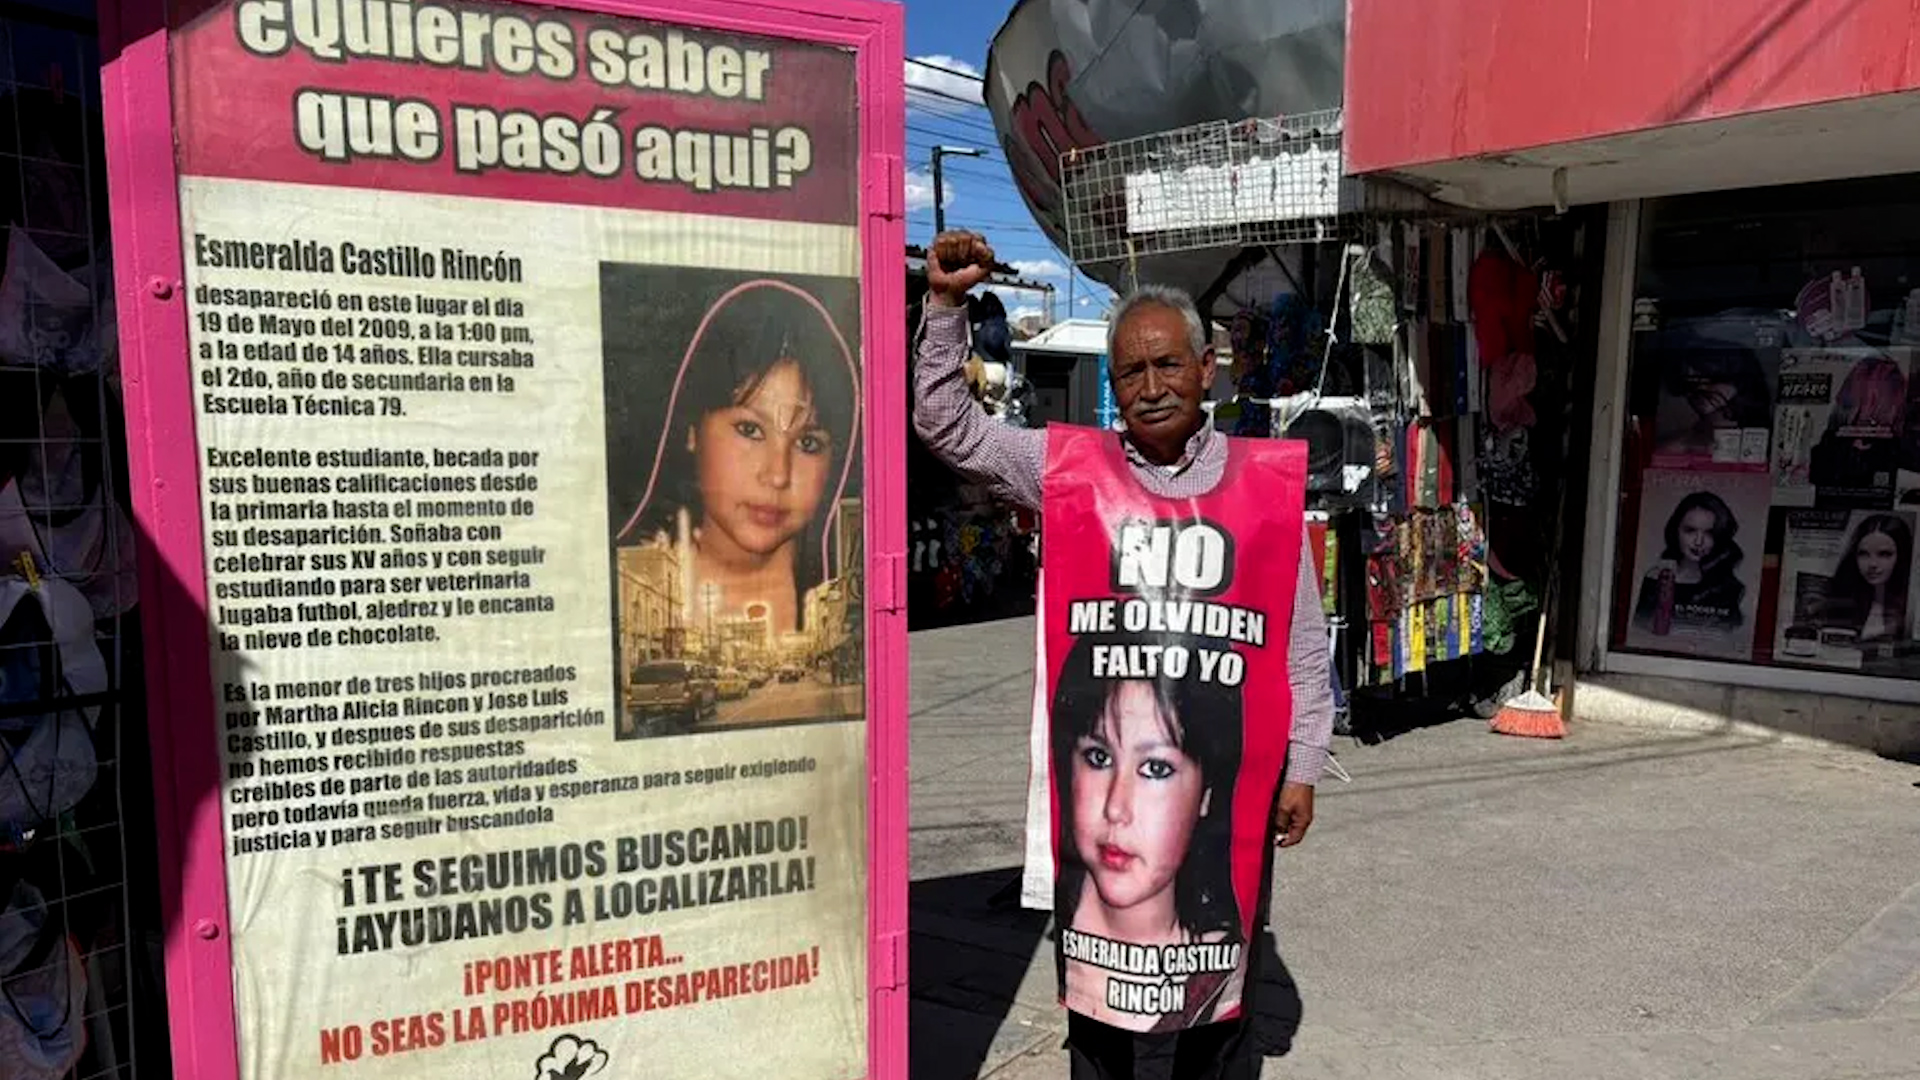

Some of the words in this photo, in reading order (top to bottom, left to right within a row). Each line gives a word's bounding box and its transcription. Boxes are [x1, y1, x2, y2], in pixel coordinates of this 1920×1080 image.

[589, 27, 771, 99] saber
[296, 90, 439, 157] que
[456, 108, 621, 175] pasó
[637, 126, 810, 189] aqui?
[195, 234, 333, 272] Esmeralda
[341, 242, 435, 279] Castillo
[441, 249, 522, 282] Rincón
[196, 285, 331, 311] desapareció
[337, 293, 361, 311] en
[368, 295, 411, 313] este
[416, 295, 466, 317] lugar
[472, 298, 489, 317] el
[199, 312, 221, 332] 19
[228, 314, 253, 333] de
[260, 315, 314, 338] Mayo
[321, 318, 353, 337] del
[360, 318, 414, 340] 2009,
[420, 325, 431, 339] a
[436, 322, 452, 340] la
[458, 323, 495, 341] 1:00
[501, 326, 534, 344] pm,
[200, 343, 212, 360] a
[218, 340, 237, 360] la
[244, 341, 296, 361] edad
[302, 343, 327, 362] de
[333, 344, 354, 362] 14
[361, 345, 413, 365] años.
[419, 347, 452, 365] Ella
[458, 349, 534, 368] cursaba
[202, 368, 221, 387] el
[228, 368, 272, 390] 2do,
[278, 368, 317, 389] año
[322, 370, 346, 390] de
[353, 372, 464, 391] secundaria
[470, 376, 492, 392] en
[497, 374, 514, 392] la
[204, 394, 287, 414] Escuela
[293, 396, 374, 416] Técnica
[380, 397, 406, 416] 79.
[208, 449, 310, 468] Excelente
[317, 449, 429, 468] estudiante,
[434, 449, 502, 467] becada
[509, 451, 538, 469] por
[209, 475, 247, 493] sus
[253, 474, 330, 493] buenas
[336, 473, 476, 492] calificaciones
[481, 472, 538, 491] desde
[211, 501, 231, 521] la
[236, 500, 328, 521] primaria
[334, 499, 388, 518] hasta
[394, 499, 411, 518] el
[418, 499, 506, 517] momento
[511, 498, 534, 516] de
[213, 528, 238, 546] su
[244, 524, 386, 546] desaparición.
[391, 523, 461, 542] Soñaba
[468, 524, 501, 540] con
[214, 553, 305, 573] celebrar
[311, 552, 346, 570] sus
[352, 550, 375, 569] XV
[381, 548, 427, 568] años
[433, 552, 442, 569] y
[447, 550, 481, 566] con
[487, 547, 545, 568] seguir
[1118, 525, 1224, 588] NO
[216, 578, 335, 599] estudiando
[341, 578, 384, 598] para
[391, 577, 421, 593] ser
[427, 572, 529, 591] veterinaria
[367, 599, 438, 620] ajedrez
[442, 600, 451, 618] y
[457, 598, 474, 615] le
[480, 596, 554, 614] encanta
[1070, 602, 1115, 632] ME
[1124, 601, 1264, 645] OLVIDEN
[221, 632, 239, 651] la
[246, 632, 301, 649] nieve
[308, 628, 332, 646] de
[338, 625, 439, 645] chocolate.
[224, 683, 245, 702] Es
[251, 682, 270, 700] la
[276, 679, 341, 698] menor
[347, 675, 370, 695] de
[376, 674, 413, 693] tres
[419, 670, 466, 692] hijos
[471, 665, 575, 688] procreados
[1093, 646, 1189, 678] FALTO
[1199, 649, 1244, 685] YO
[226, 710, 259, 730] por
[266, 703, 337, 724] Martha
[344, 699, 397, 720] Alicia
[404, 694, 469, 715] Rincon
[474, 694, 483, 713] y
[489, 690, 527, 710] Jose
[533, 688, 568, 707] Luis
[228, 728, 311, 752] Castillo,
[317, 729, 325, 748] y
[332, 721, 415, 746] despues
[421, 718, 442, 738] de
[448, 718, 480, 736] sus
[486, 708, 604, 734] desaparición
[230, 760, 253, 778] no
[260, 753, 327, 777] hemos
[335, 749, 415, 770] recibido
[421, 739, 524, 765] respuestas
[231, 776, 314, 803] creibles
[322, 775, 345, 796] de
[351, 771, 400, 794] parte
[408, 769, 429, 788] de
[435, 765, 462, 786] las
[468, 758, 576, 783] autoridades
[232, 808, 278, 830] pero
[285, 798, 358, 824] todavía
[364, 797, 423, 820] queda
[429, 788, 488, 811] fuerza,
[493, 783, 530, 805] vida
[535, 784, 544, 803] y
[552, 776, 638, 799] esperanza
[644, 771, 680, 790] para
[685, 764, 736, 785] seguir
[740, 757, 815, 778] exigiendo
[234, 827, 310, 855] justicia
[317, 829, 326, 847] y
[332, 821, 375, 845] para
[382, 817, 441, 839] seguir
[447, 806, 553, 832] buscandola
[342, 862, 403, 907] ¡TE
[414, 839, 606, 898] SEGUIMOS
[616, 817, 808, 874] BUSCANDO!
[337, 892, 552, 954] ¡AYUDANOS
[564, 885, 586, 925] A
[594, 857, 816, 921] LOCALIZARLA!
[463, 946, 562, 996] ¡PONTE
[570, 935, 683, 981] ALERTA...
[1063, 930, 1159, 975] ESMERALDA
[1163, 944, 1241, 974] CASTILLO
[321, 1028, 362, 1065] NO
[372, 1013, 445, 1056] SEAS
[453, 1008, 486, 1043] LA
[494, 987, 617, 1034] PRÓXIMA
[625, 947, 819, 1009] DESAPARECIDA!
[1108, 975, 1184, 1012] RINCÓN
